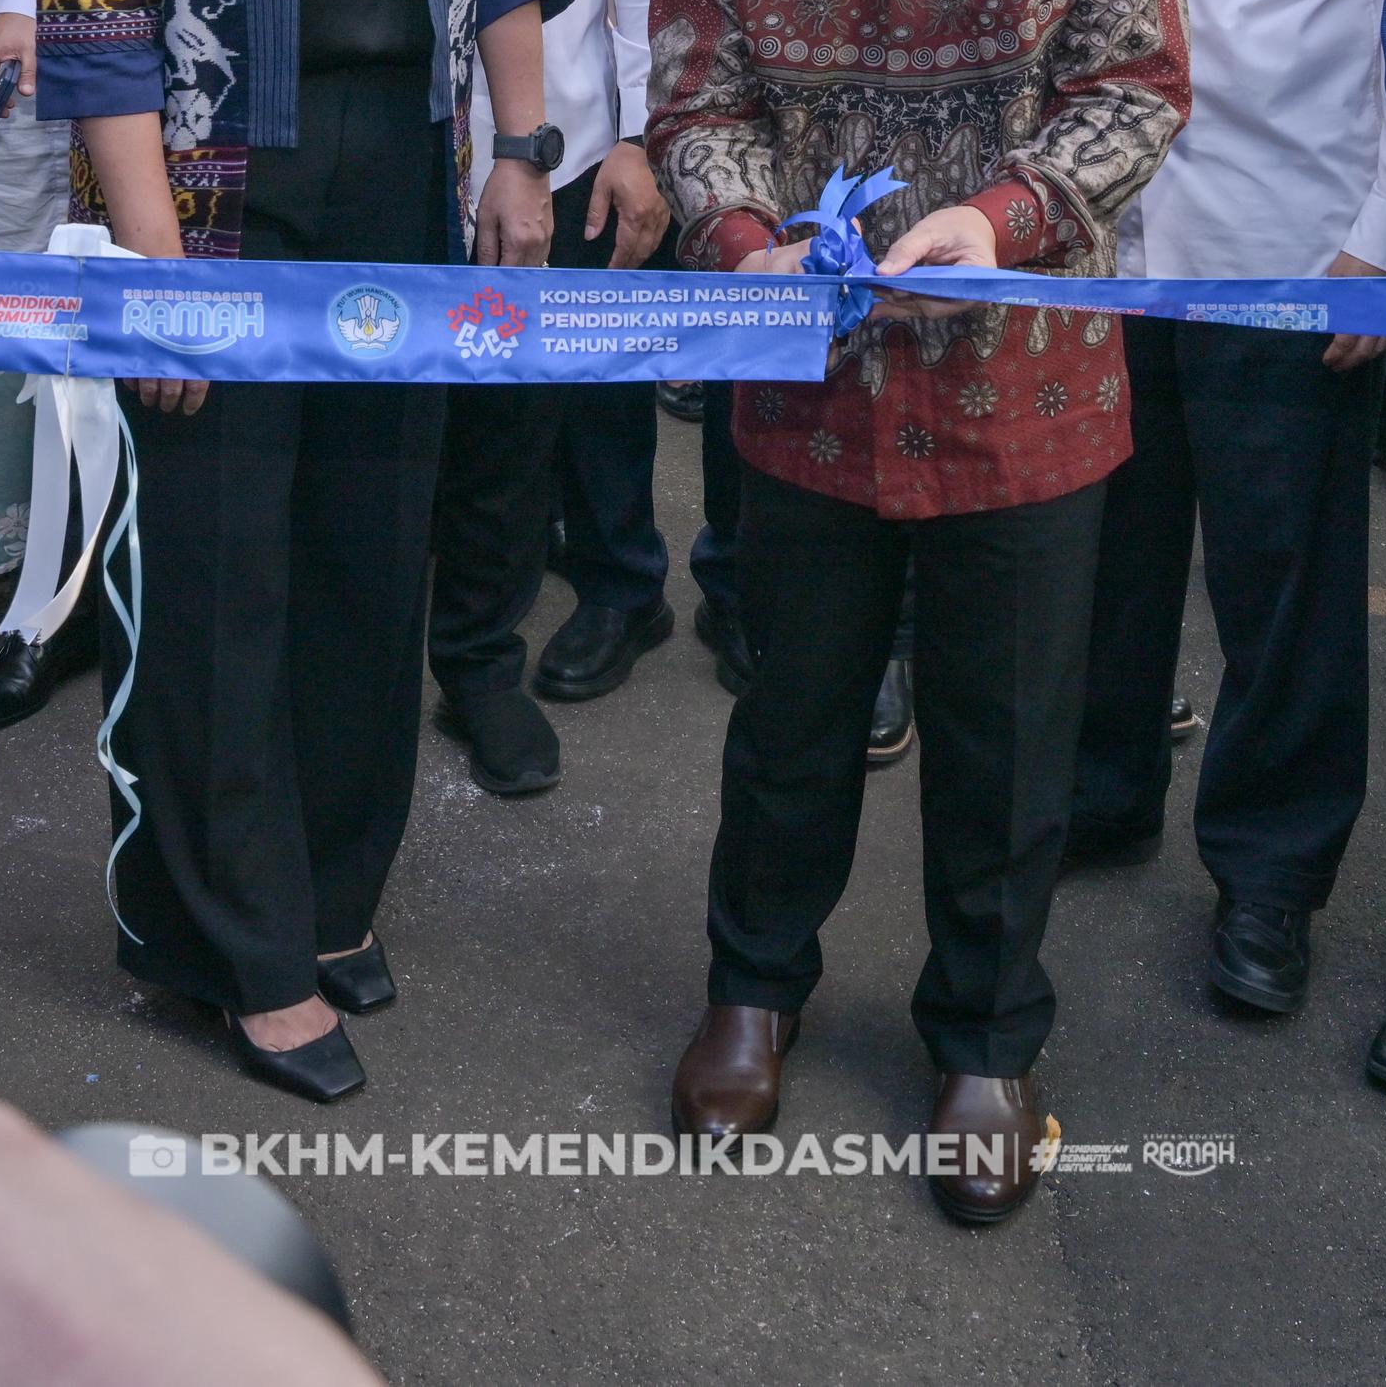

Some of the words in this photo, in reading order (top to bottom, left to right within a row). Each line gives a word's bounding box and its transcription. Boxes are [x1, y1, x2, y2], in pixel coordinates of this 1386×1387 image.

[123, 289, 262, 301] KEMENDIKDASMEN
[337, 295, 348, 308] TUT
[347, 288, 364, 297] WURI
[365, 287, 400, 309] HANDAYANI
[540, 289, 688, 304] KONSOLIDASI
[694, 286, 810, 302] NASIONAL
[122, 300, 264, 338] RAMAH
[540, 312, 678, 328] PENDIDIKAN
[683, 311, 759, 326] DASAR
[765, 311, 811, 326] DAN
[28, 324, 88, 340] SEMUA
[541, 337, 617, 353] TAHUN
[623, 337, 678, 352] 2025
